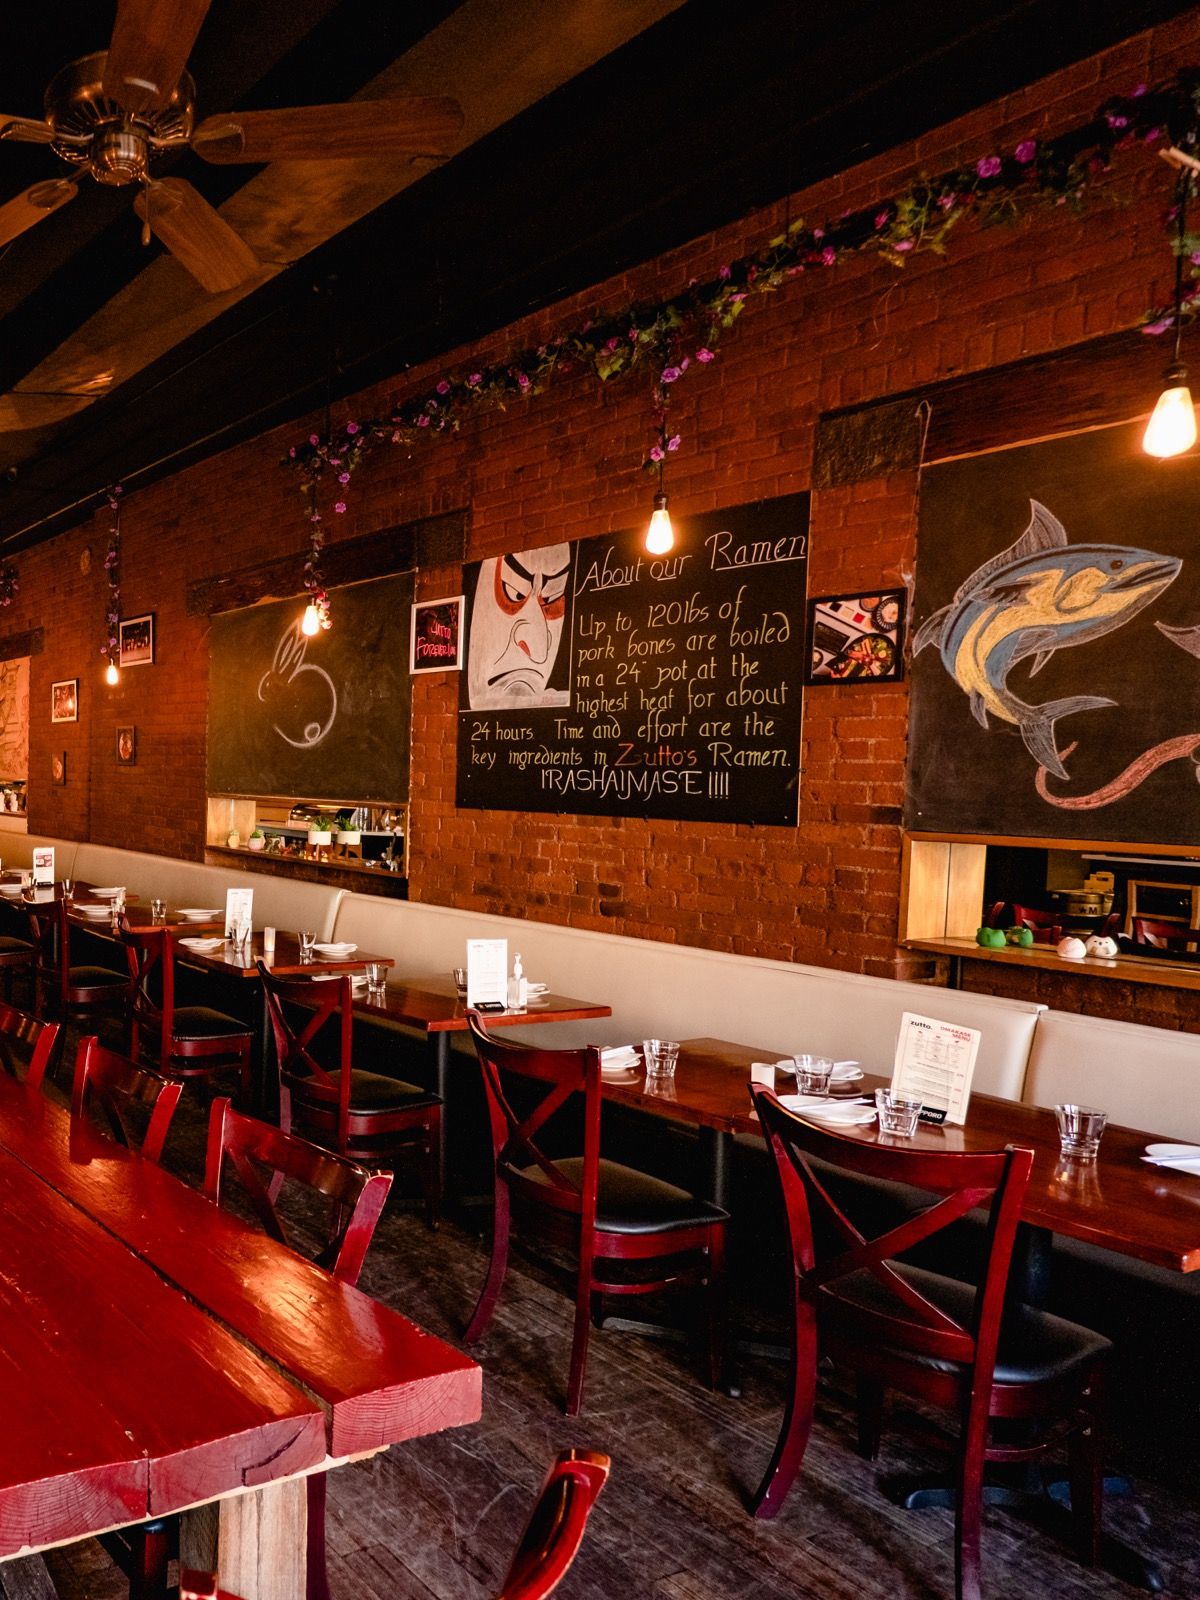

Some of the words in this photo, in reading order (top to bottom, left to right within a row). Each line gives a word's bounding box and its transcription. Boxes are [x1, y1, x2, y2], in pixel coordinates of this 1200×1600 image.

[575, 546, 644, 593] About
[650, 555, 692, 579] our
[705, 531, 806, 569] Ramen
[579, 613, 606, 640] Up
[615, 611, 632, 632] to
[718, 585, 747, 620] of
[578, 635, 615, 667] pork
[627, 629, 675, 658] bones
[686, 634, 717, 651] are
[730, 612, 790, 647] boiled
[577, 674, 590, 688] in
[595, 673, 604, 686] a
[651, 659, 688, 690] pot
[697, 656, 717, 679] at
[732, 653, 759, 677] the
[576, 691, 629, 718] highest
[640, 688, 675, 711] heat
[688, 678, 716, 714] for
[726, 676, 788, 707] about
[471, 721, 490, 741] 24
[553, 718, 584, 740] Time
[592, 715, 621, 739] and
[637, 708, 688, 743] effort
[699, 721, 732, 737] are
[744, 712, 775, 736] the
[471, 745, 496, 770] key
[508, 745, 583, 770] ingredients
[594, 750, 607, 766] in
[614, 743, 697, 766] Zutto's
[707, 742, 791, 767] Ramen.
